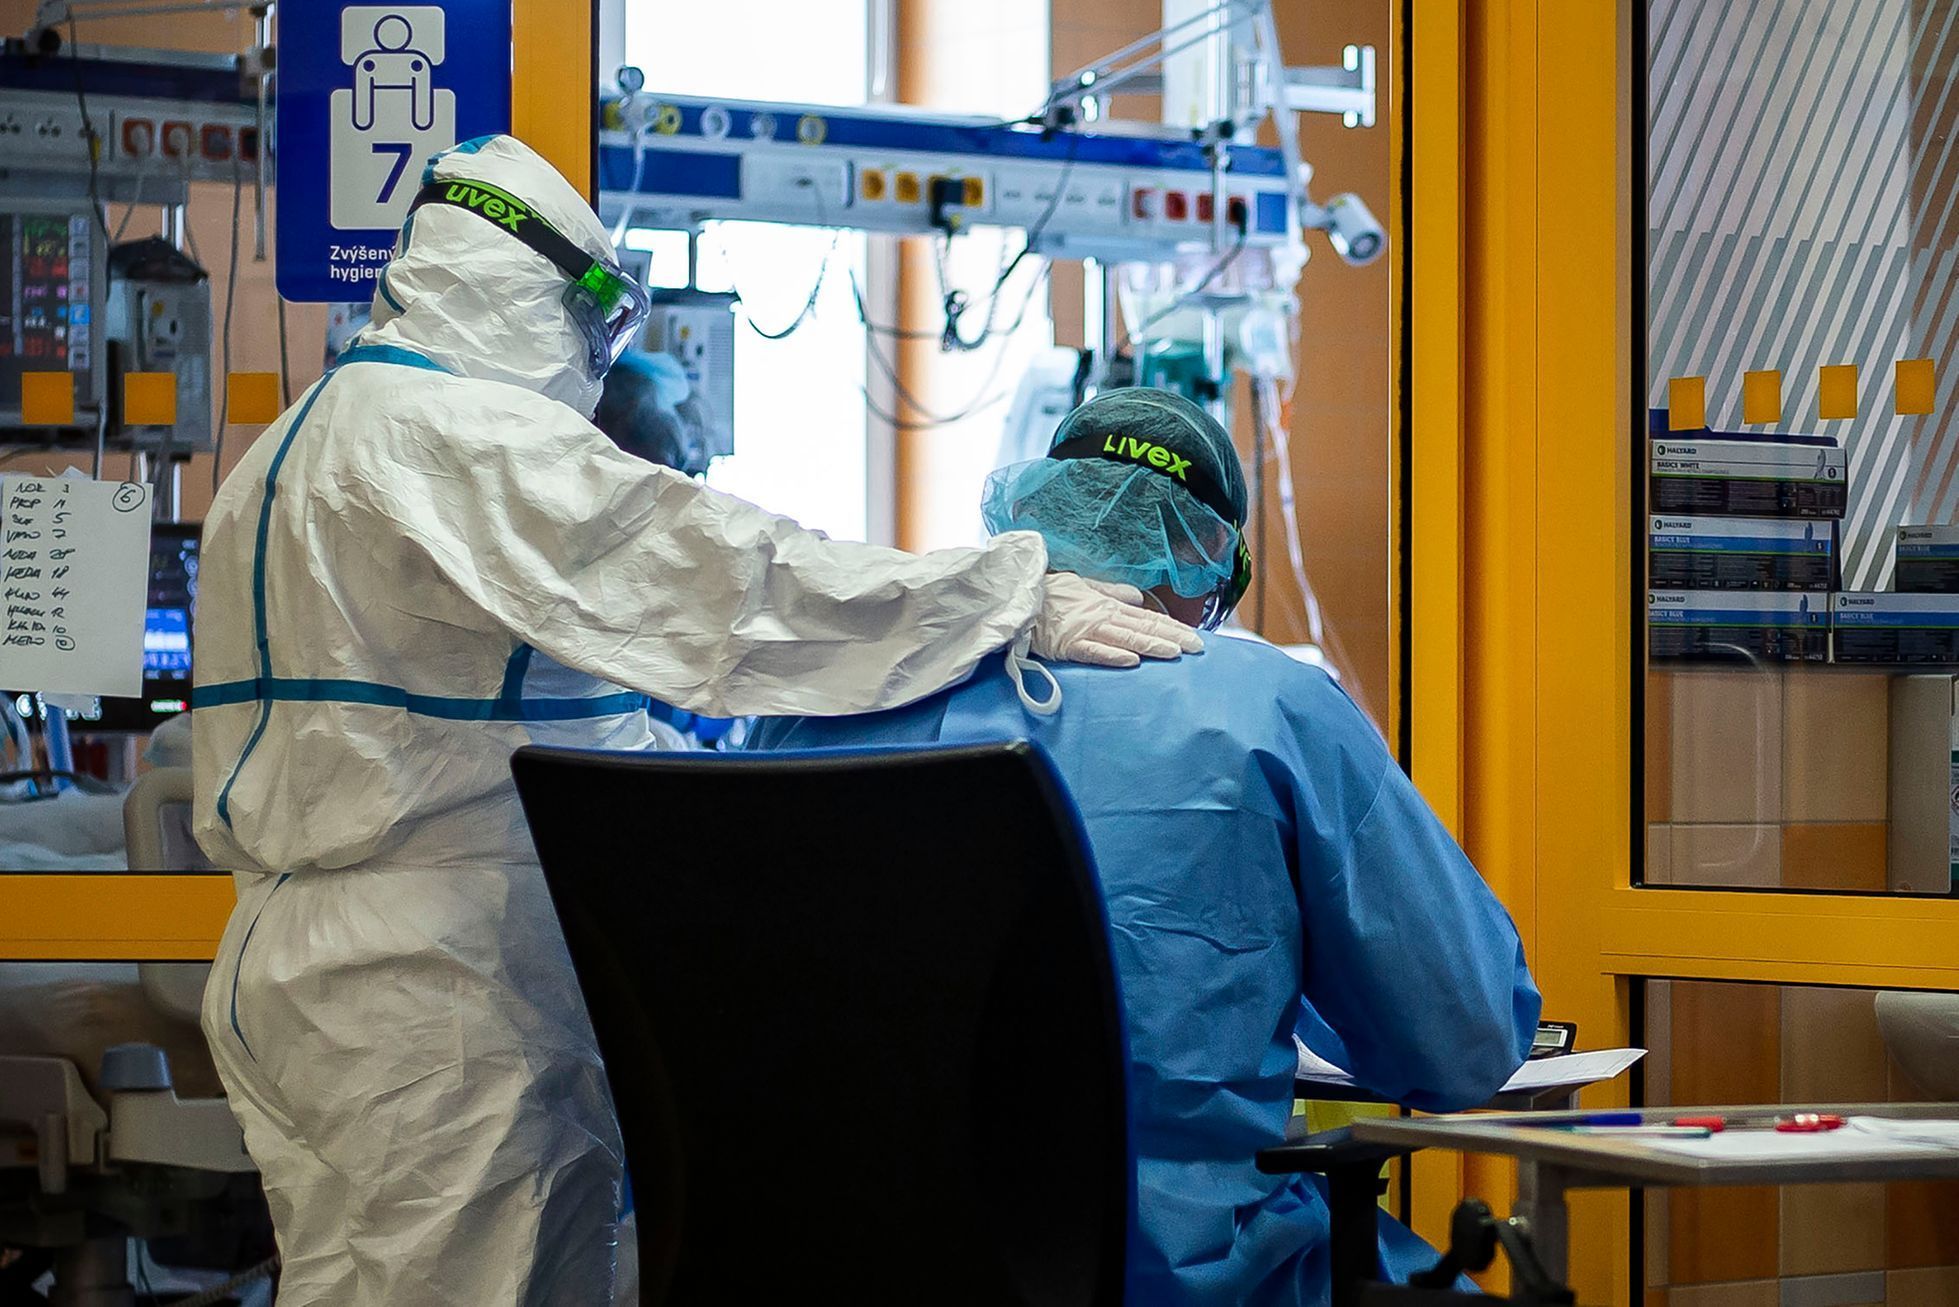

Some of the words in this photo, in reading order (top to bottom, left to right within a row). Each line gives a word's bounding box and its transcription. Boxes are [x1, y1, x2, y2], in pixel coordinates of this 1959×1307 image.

[371, 143, 413, 204] 7
[445, 184, 528, 233] uvex
[1667, 447, 1697, 455] HALYARD
[120, 489, 137, 504] 6
[52, 512, 72, 525] 5
